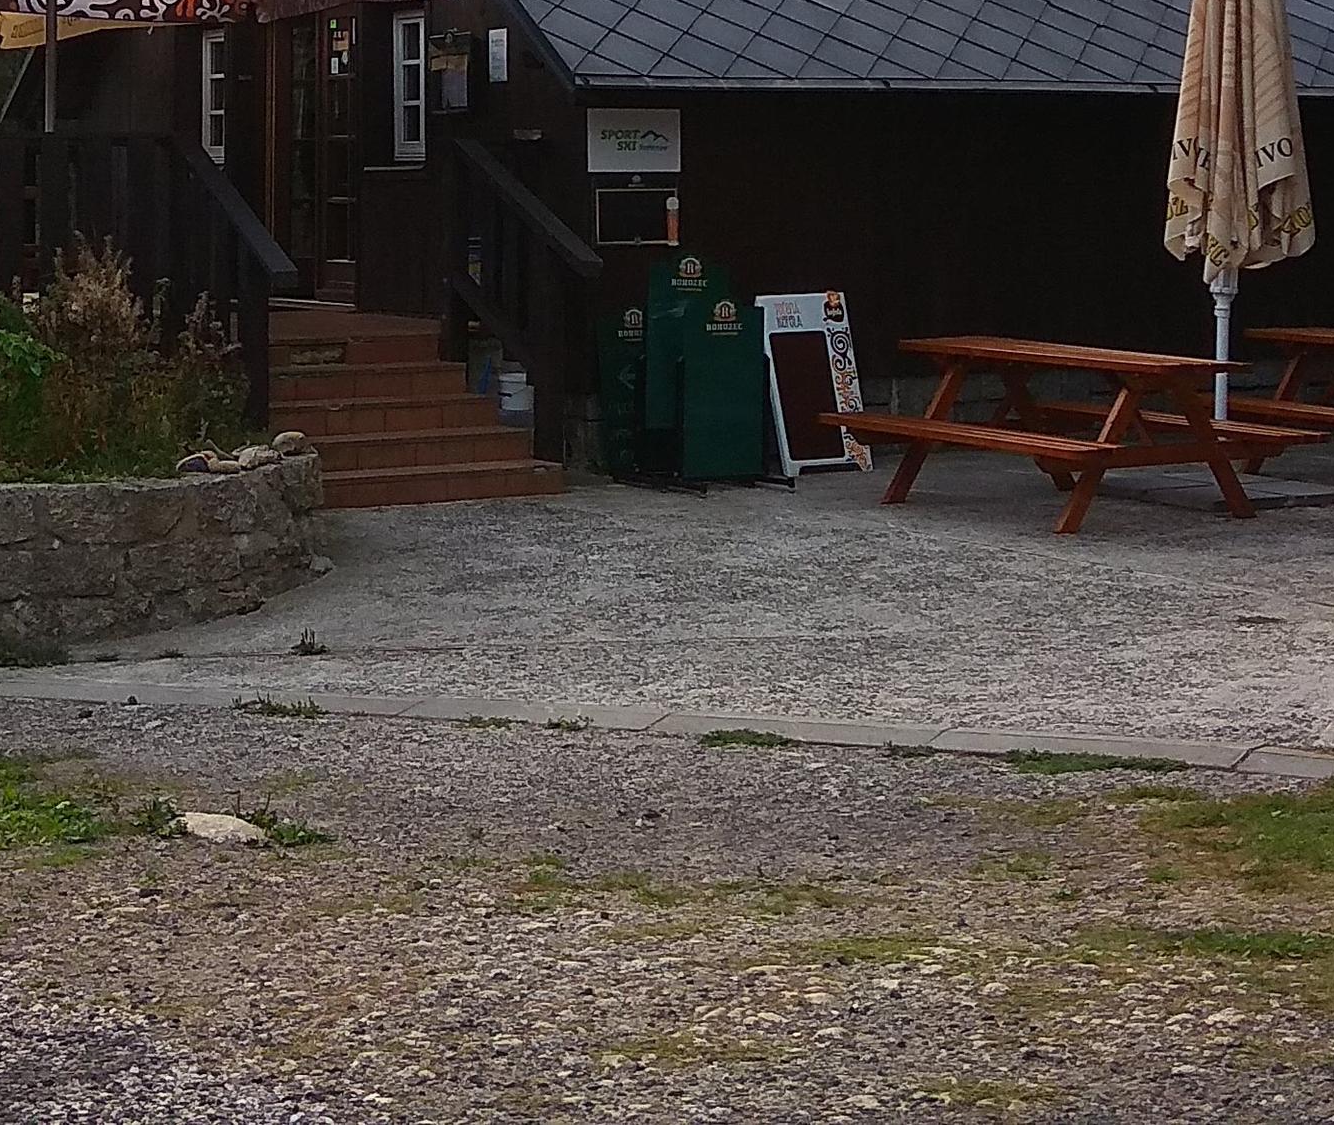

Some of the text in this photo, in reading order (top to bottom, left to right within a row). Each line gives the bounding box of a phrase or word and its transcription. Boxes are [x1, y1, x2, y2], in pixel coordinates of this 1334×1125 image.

[600, 129, 641, 140] SPORT
[616, 140, 638, 151] SKI
[1254, 137, 1293, 168] IVO
